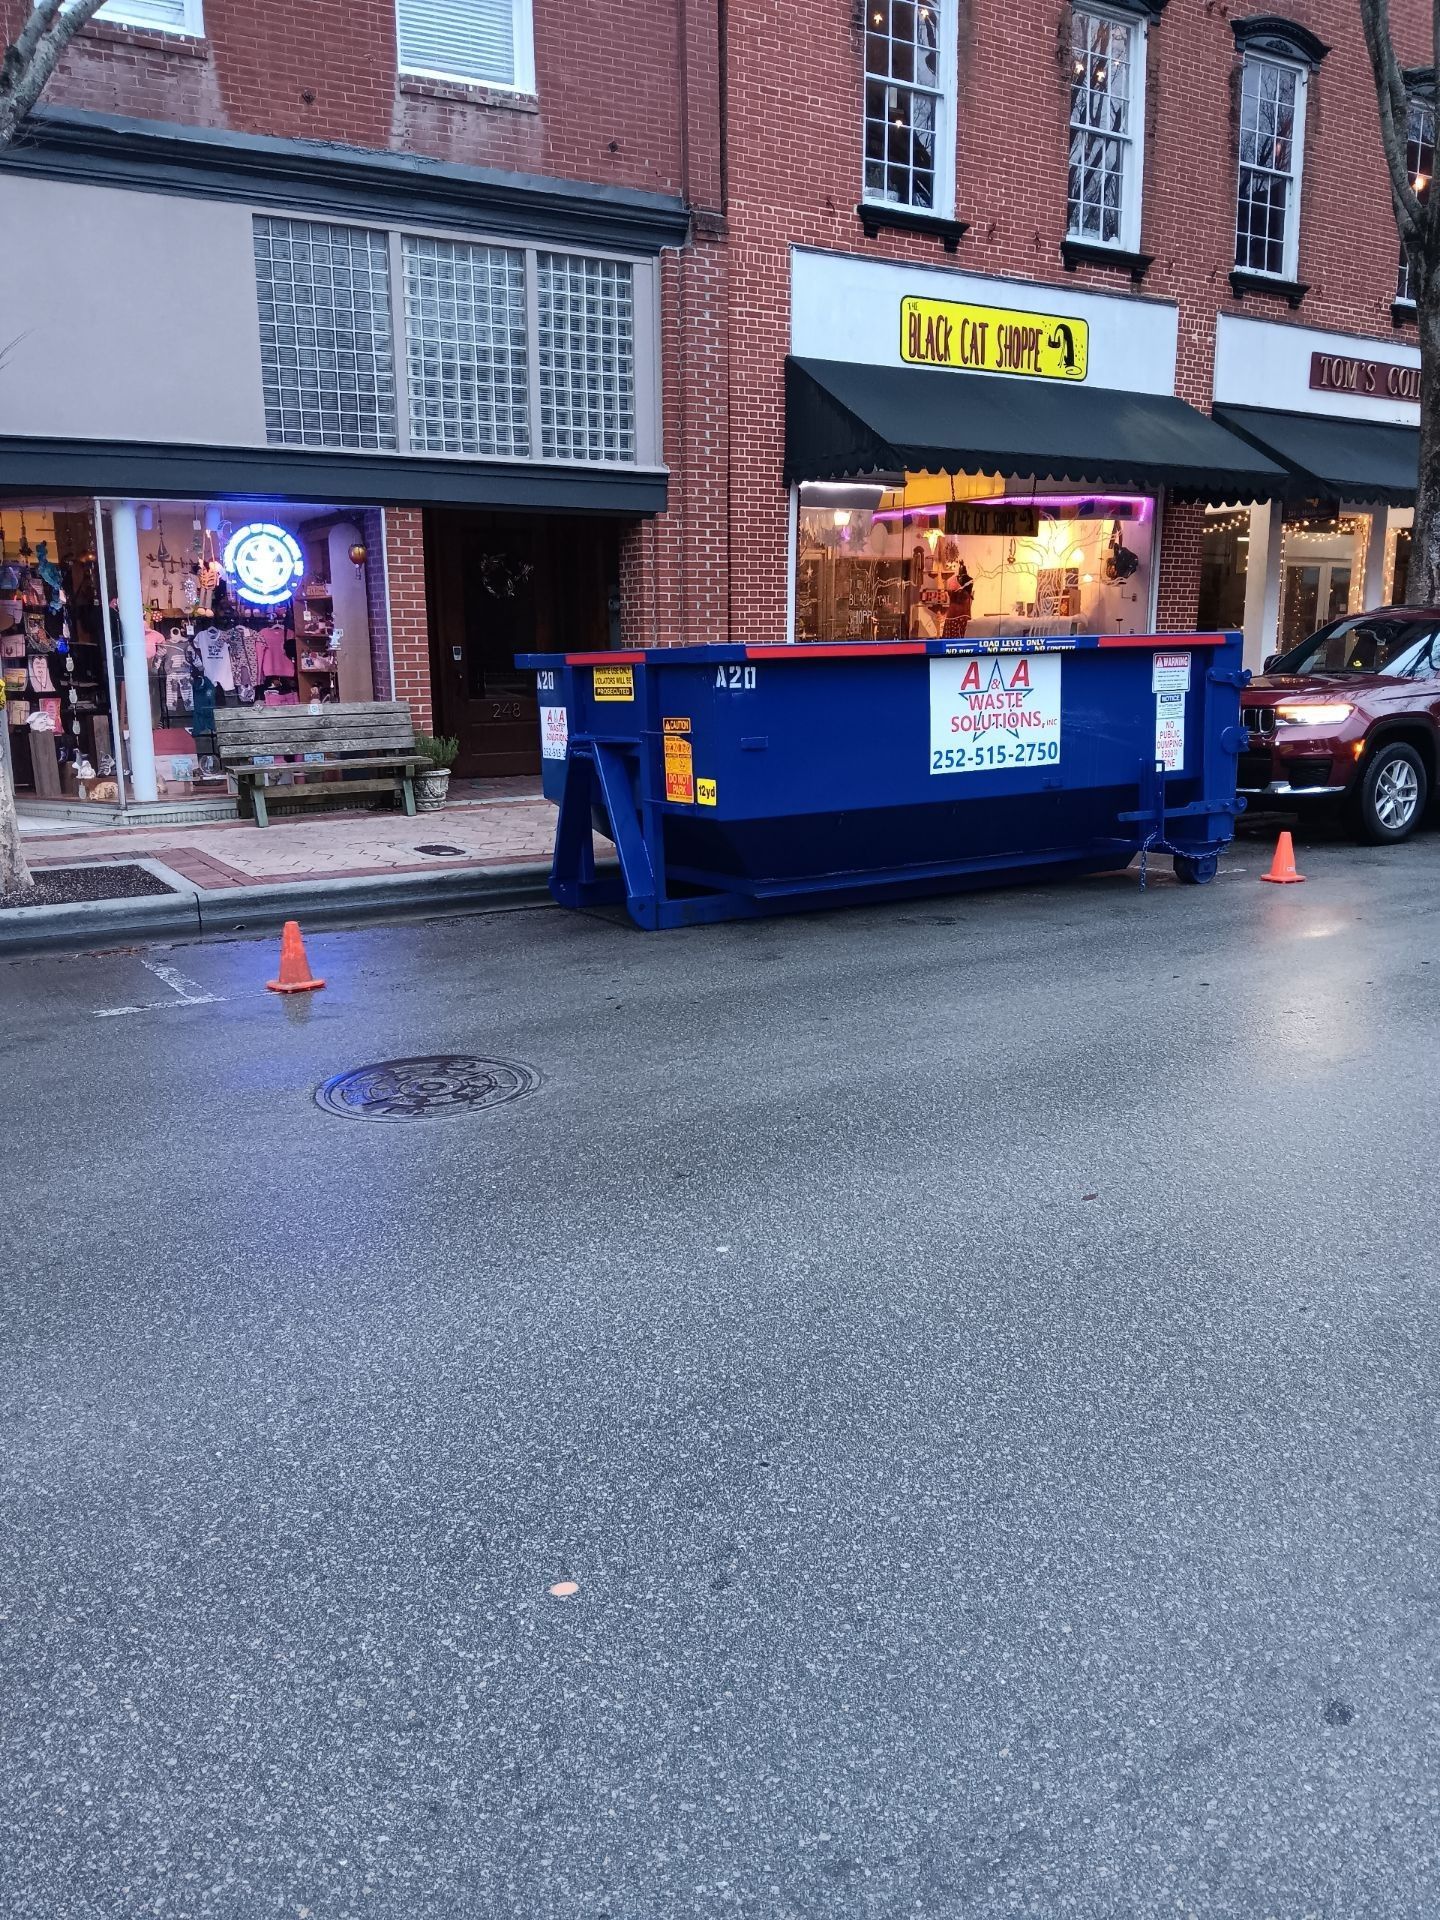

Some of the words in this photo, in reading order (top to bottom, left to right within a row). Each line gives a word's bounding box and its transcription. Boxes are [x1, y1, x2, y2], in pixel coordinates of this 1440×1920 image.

[908, 311, 953, 361] BLACK
[960, 318, 989, 365] CAT
[995, 324, 1043, 372] SHOPPE
[1320, 356, 1377, 392] TOM'S
[979, 640, 999, 648] LOAD
[1002, 639, 1024, 647] LEVEL
[1026, 638, 1046, 646] ONLY
[1163, 656, 1188, 667] WARNING
[715, 665, 757, 689] A20
[960, 661, 981, 690] A
[990, 678, 1000, 690] &
[1009, 659, 1030, 688] A
[968, 693, 1022, 711] WASTE
[1161, 694, 1181, 702] NOTICE
[492, 702, 520, 718] 248
[670, 720, 689, 730] CAUTION
[1165, 720, 1175, 729] NO
[1160, 729, 1180, 739] PUBLIC
[1156, 739, 1182, 749] DUMPING
[932, 741, 1058, 770] 252-515-2750
[668, 773, 677, 784] DO
[677, 774, 689, 785] NOT
[672, 784, 687, 795] PARK
[698, 784, 715, 800] 12yd
